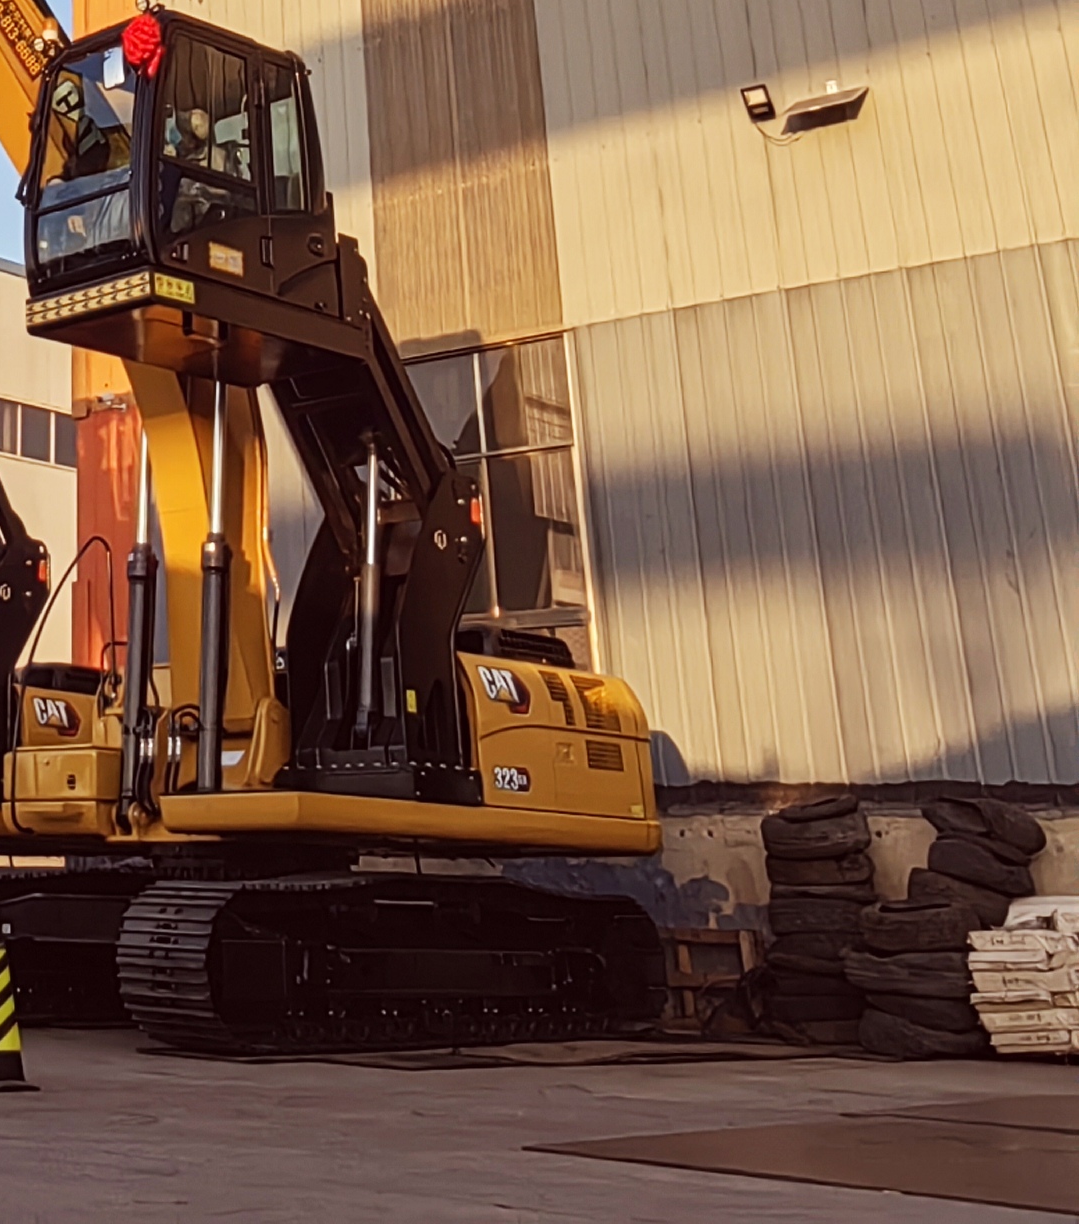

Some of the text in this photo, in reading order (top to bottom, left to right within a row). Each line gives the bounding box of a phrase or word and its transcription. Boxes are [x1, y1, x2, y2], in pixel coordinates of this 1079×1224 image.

[477, 665, 520, 704] CAT
[33, 697, 69, 728] CAT
[494, 766, 519, 791] 323
